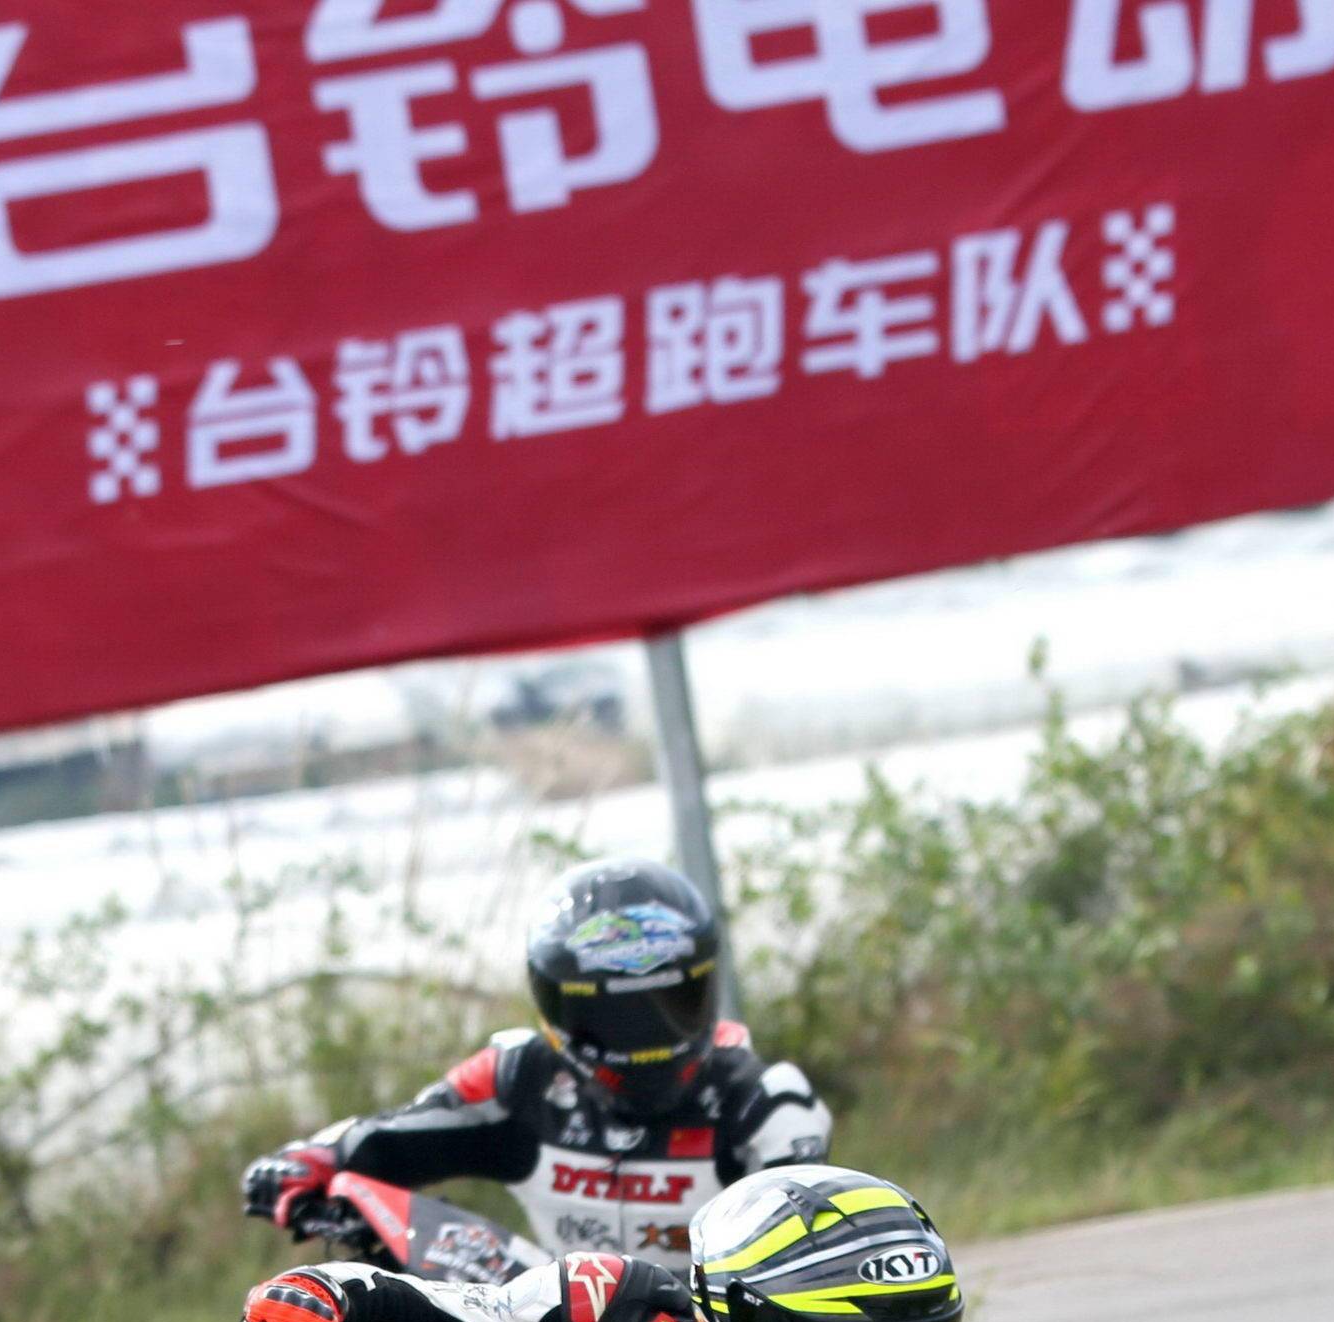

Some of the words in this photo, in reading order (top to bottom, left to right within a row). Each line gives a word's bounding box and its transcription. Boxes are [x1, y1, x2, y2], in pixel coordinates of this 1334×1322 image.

[185, 219, 1089, 489] 台铃超跑车队
[863, 1251, 934, 1281] KYT
